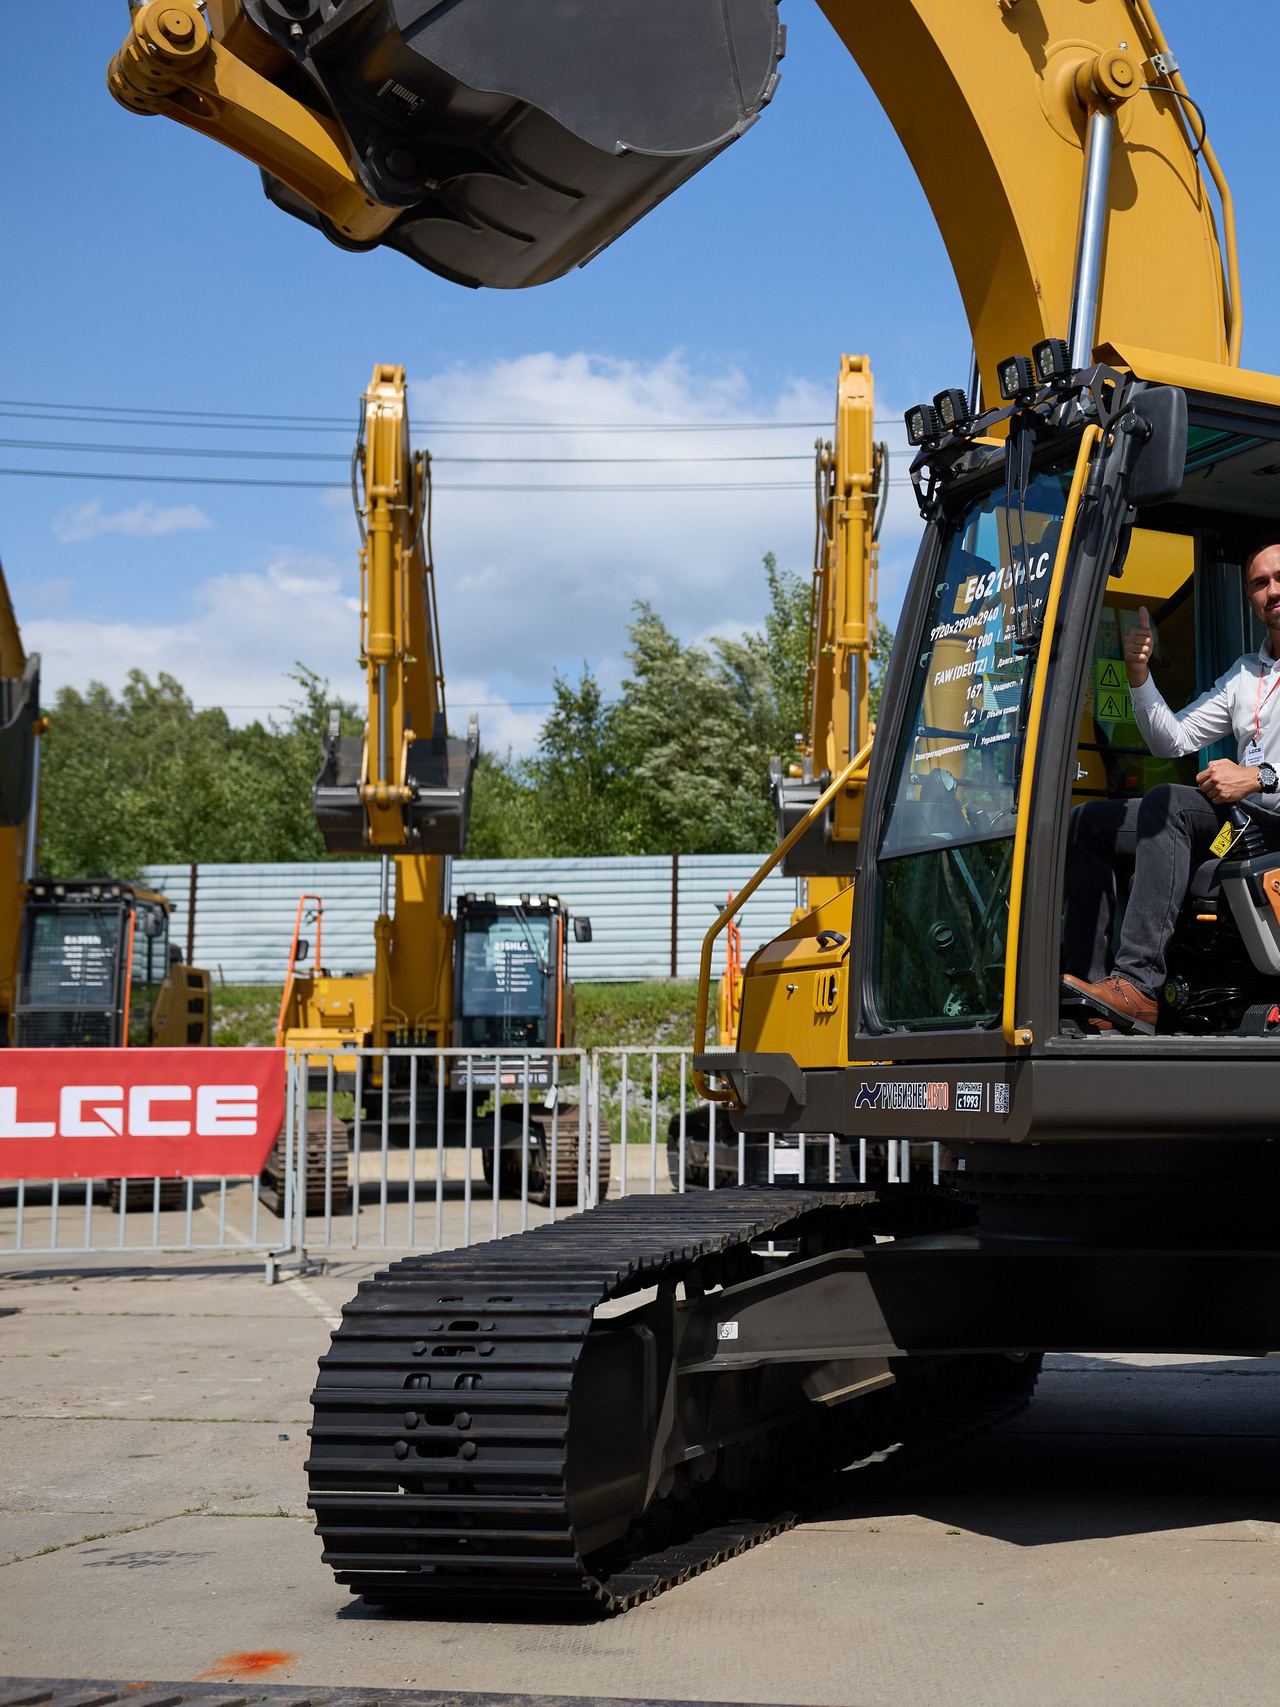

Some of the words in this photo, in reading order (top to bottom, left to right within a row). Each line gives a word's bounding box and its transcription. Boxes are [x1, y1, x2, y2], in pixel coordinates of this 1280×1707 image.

[964, 552, 1050, 604] E6215HLC
[967, 684, 982, 700] 167
[963, 709, 976, 727] 1,2
[980, 732, 1011, 746] Управление
[881, 1082, 949, 1111] РУСБИЗНЕСАВТО
